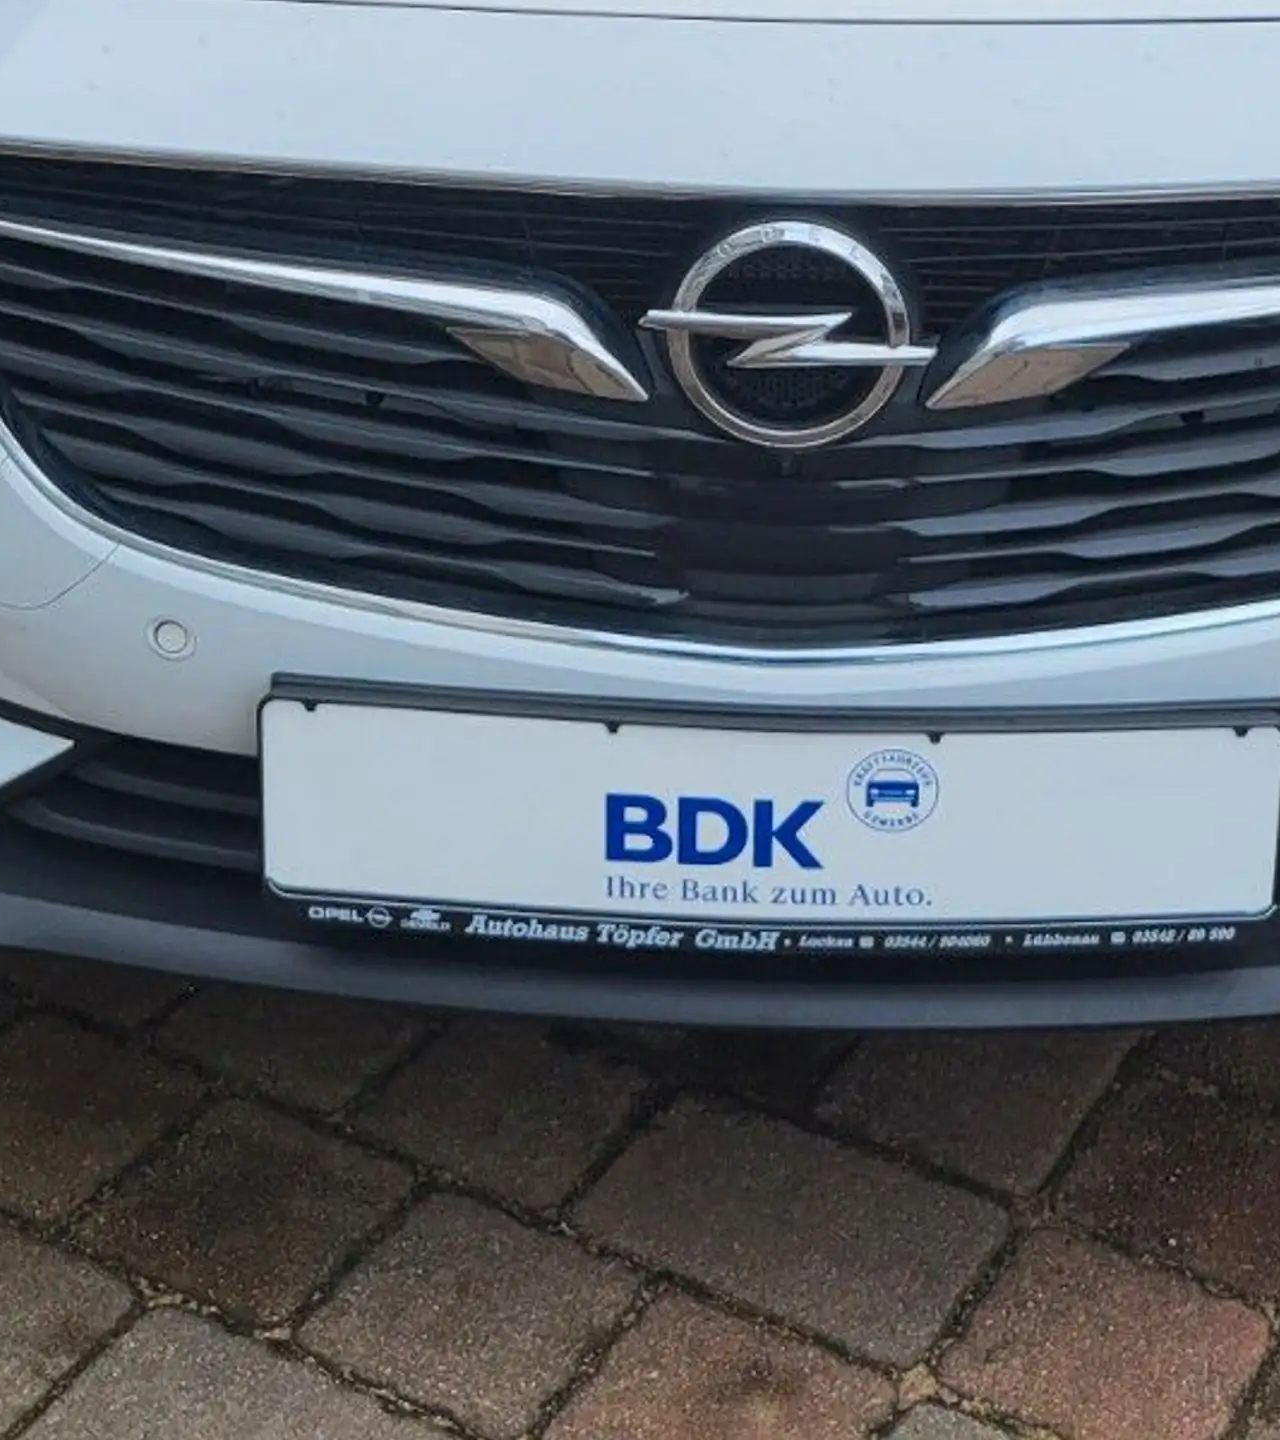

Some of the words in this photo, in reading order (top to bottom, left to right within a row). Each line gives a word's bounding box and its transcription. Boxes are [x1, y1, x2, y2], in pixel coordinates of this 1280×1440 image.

[605, 793, 825, 870] BDK
[606, 876, 669, 901] Ihre
[681, 878, 760, 904] Bank
[770, 885, 837, 906] zum
[846, 884, 934, 908] Auto.
[308, 905, 364, 923] OPEL
[464, 913, 590, 942] Autohaus
[595, 921, 684, 948] Töpfer
[693, 927, 781, 951] GmbH
